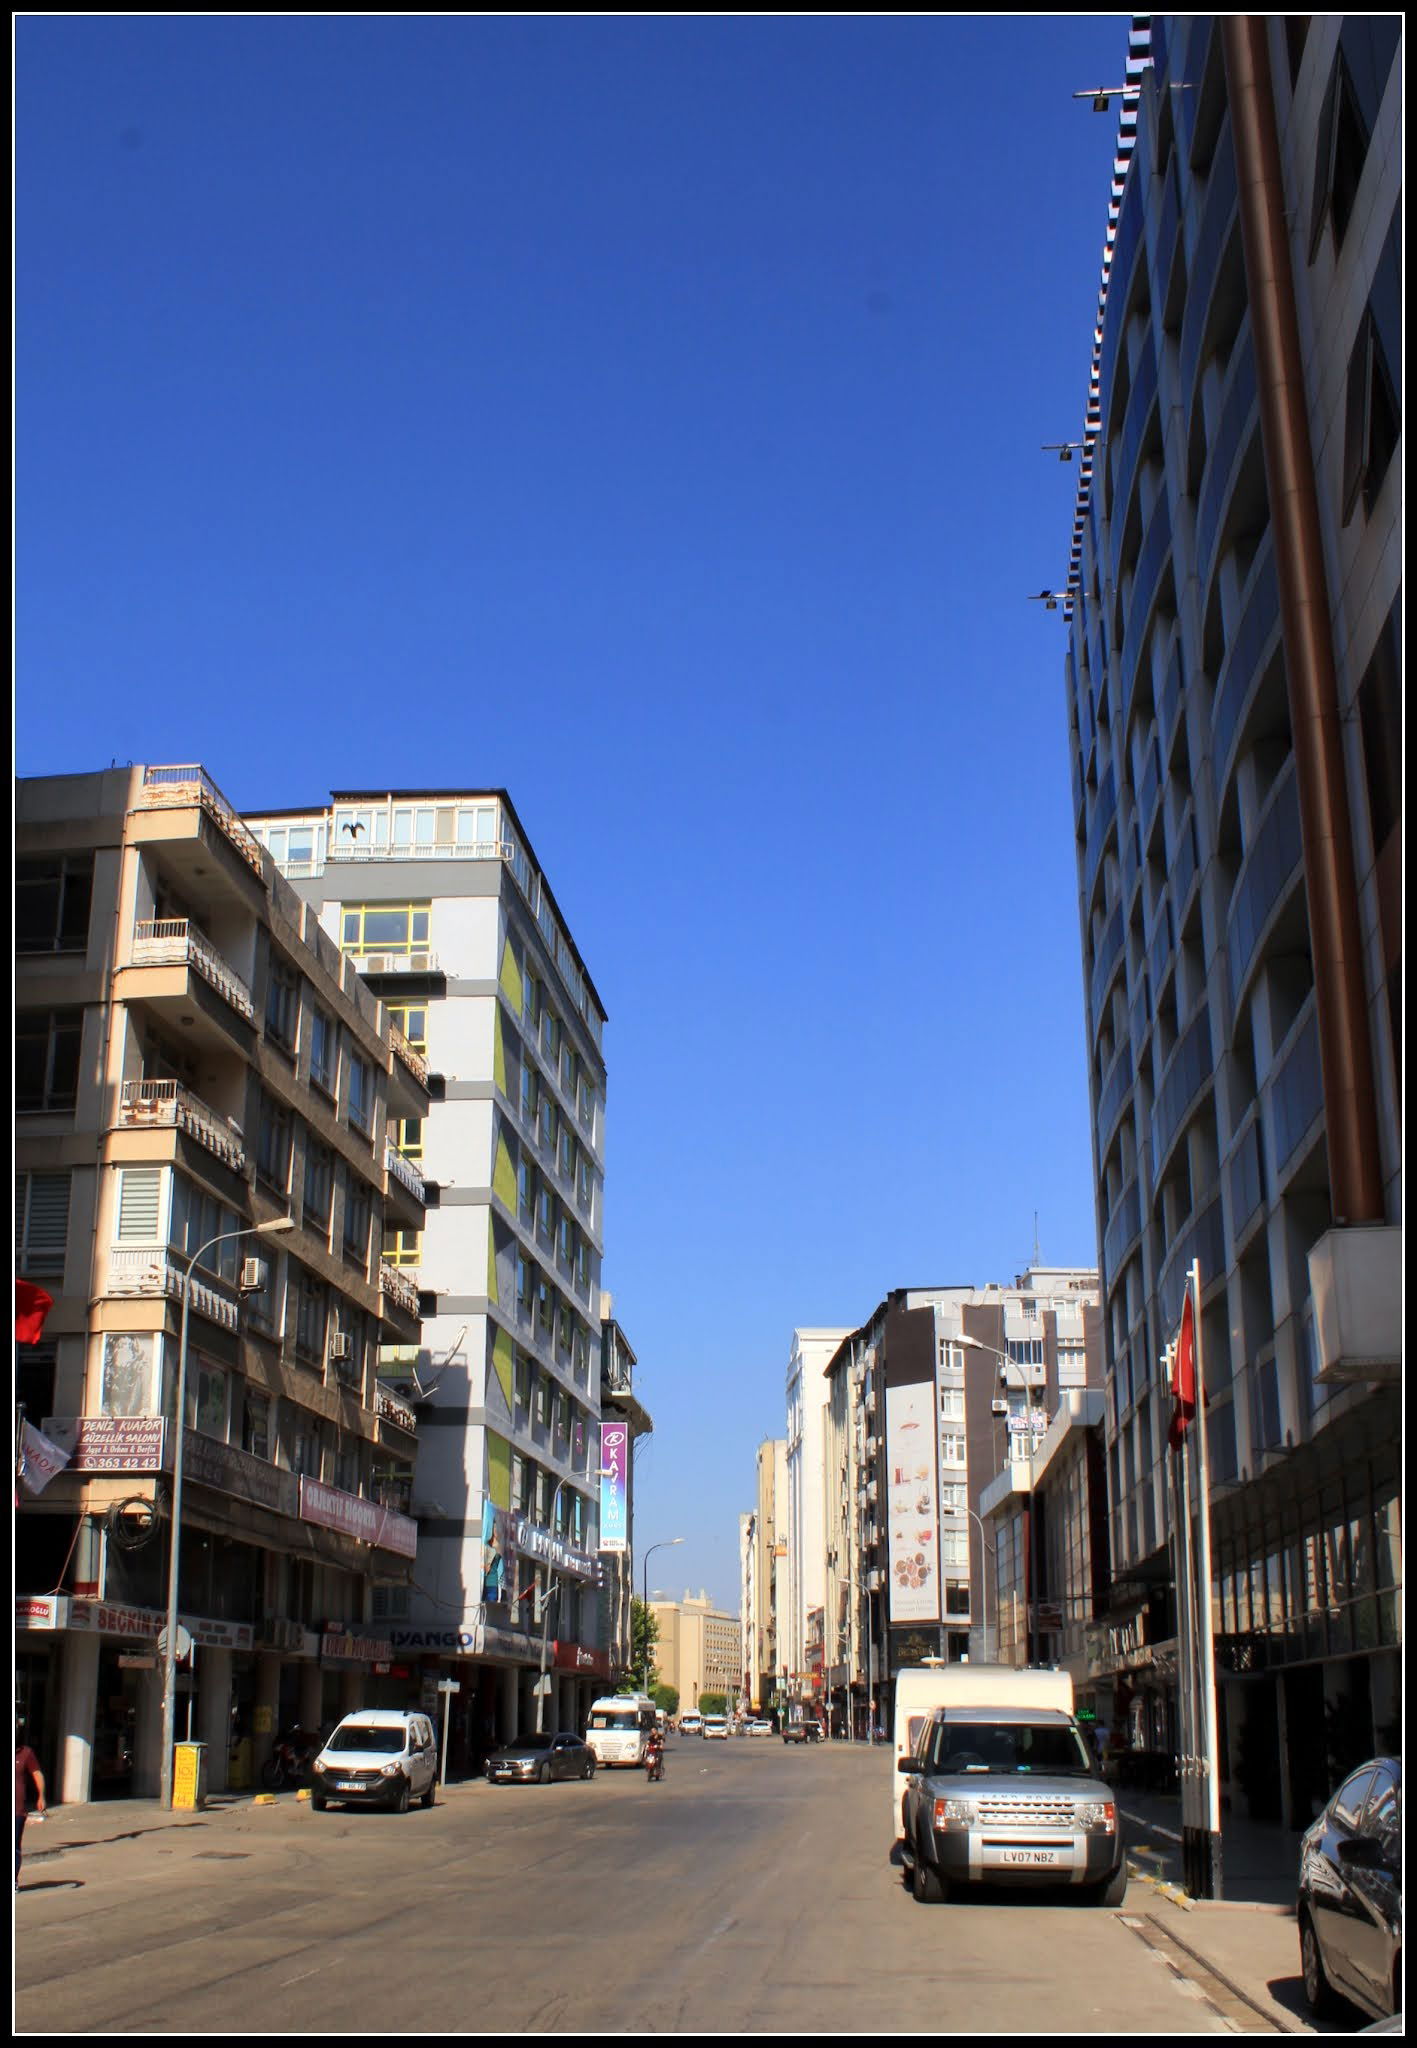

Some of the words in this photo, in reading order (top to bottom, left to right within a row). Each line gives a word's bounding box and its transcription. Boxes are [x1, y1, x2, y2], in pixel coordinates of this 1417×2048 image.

[82, 1420, 115, 1431] DENİZ
[120, 1420, 160, 1431] KUAFÖR
[82, 1432, 124, 1443] GÜZELLİK
[125, 1433, 160, 1443] SALONU
[98, 1458, 120, 1468] 363
[123, 1458, 139, 1468] 42
[141, 1458, 157, 1468] 42
[608, 1448, 619, 1520] KAVRAM
[1003, 1851, 1031, 1863] LV07
[1034, 1851, 1054, 1863] NBZ
